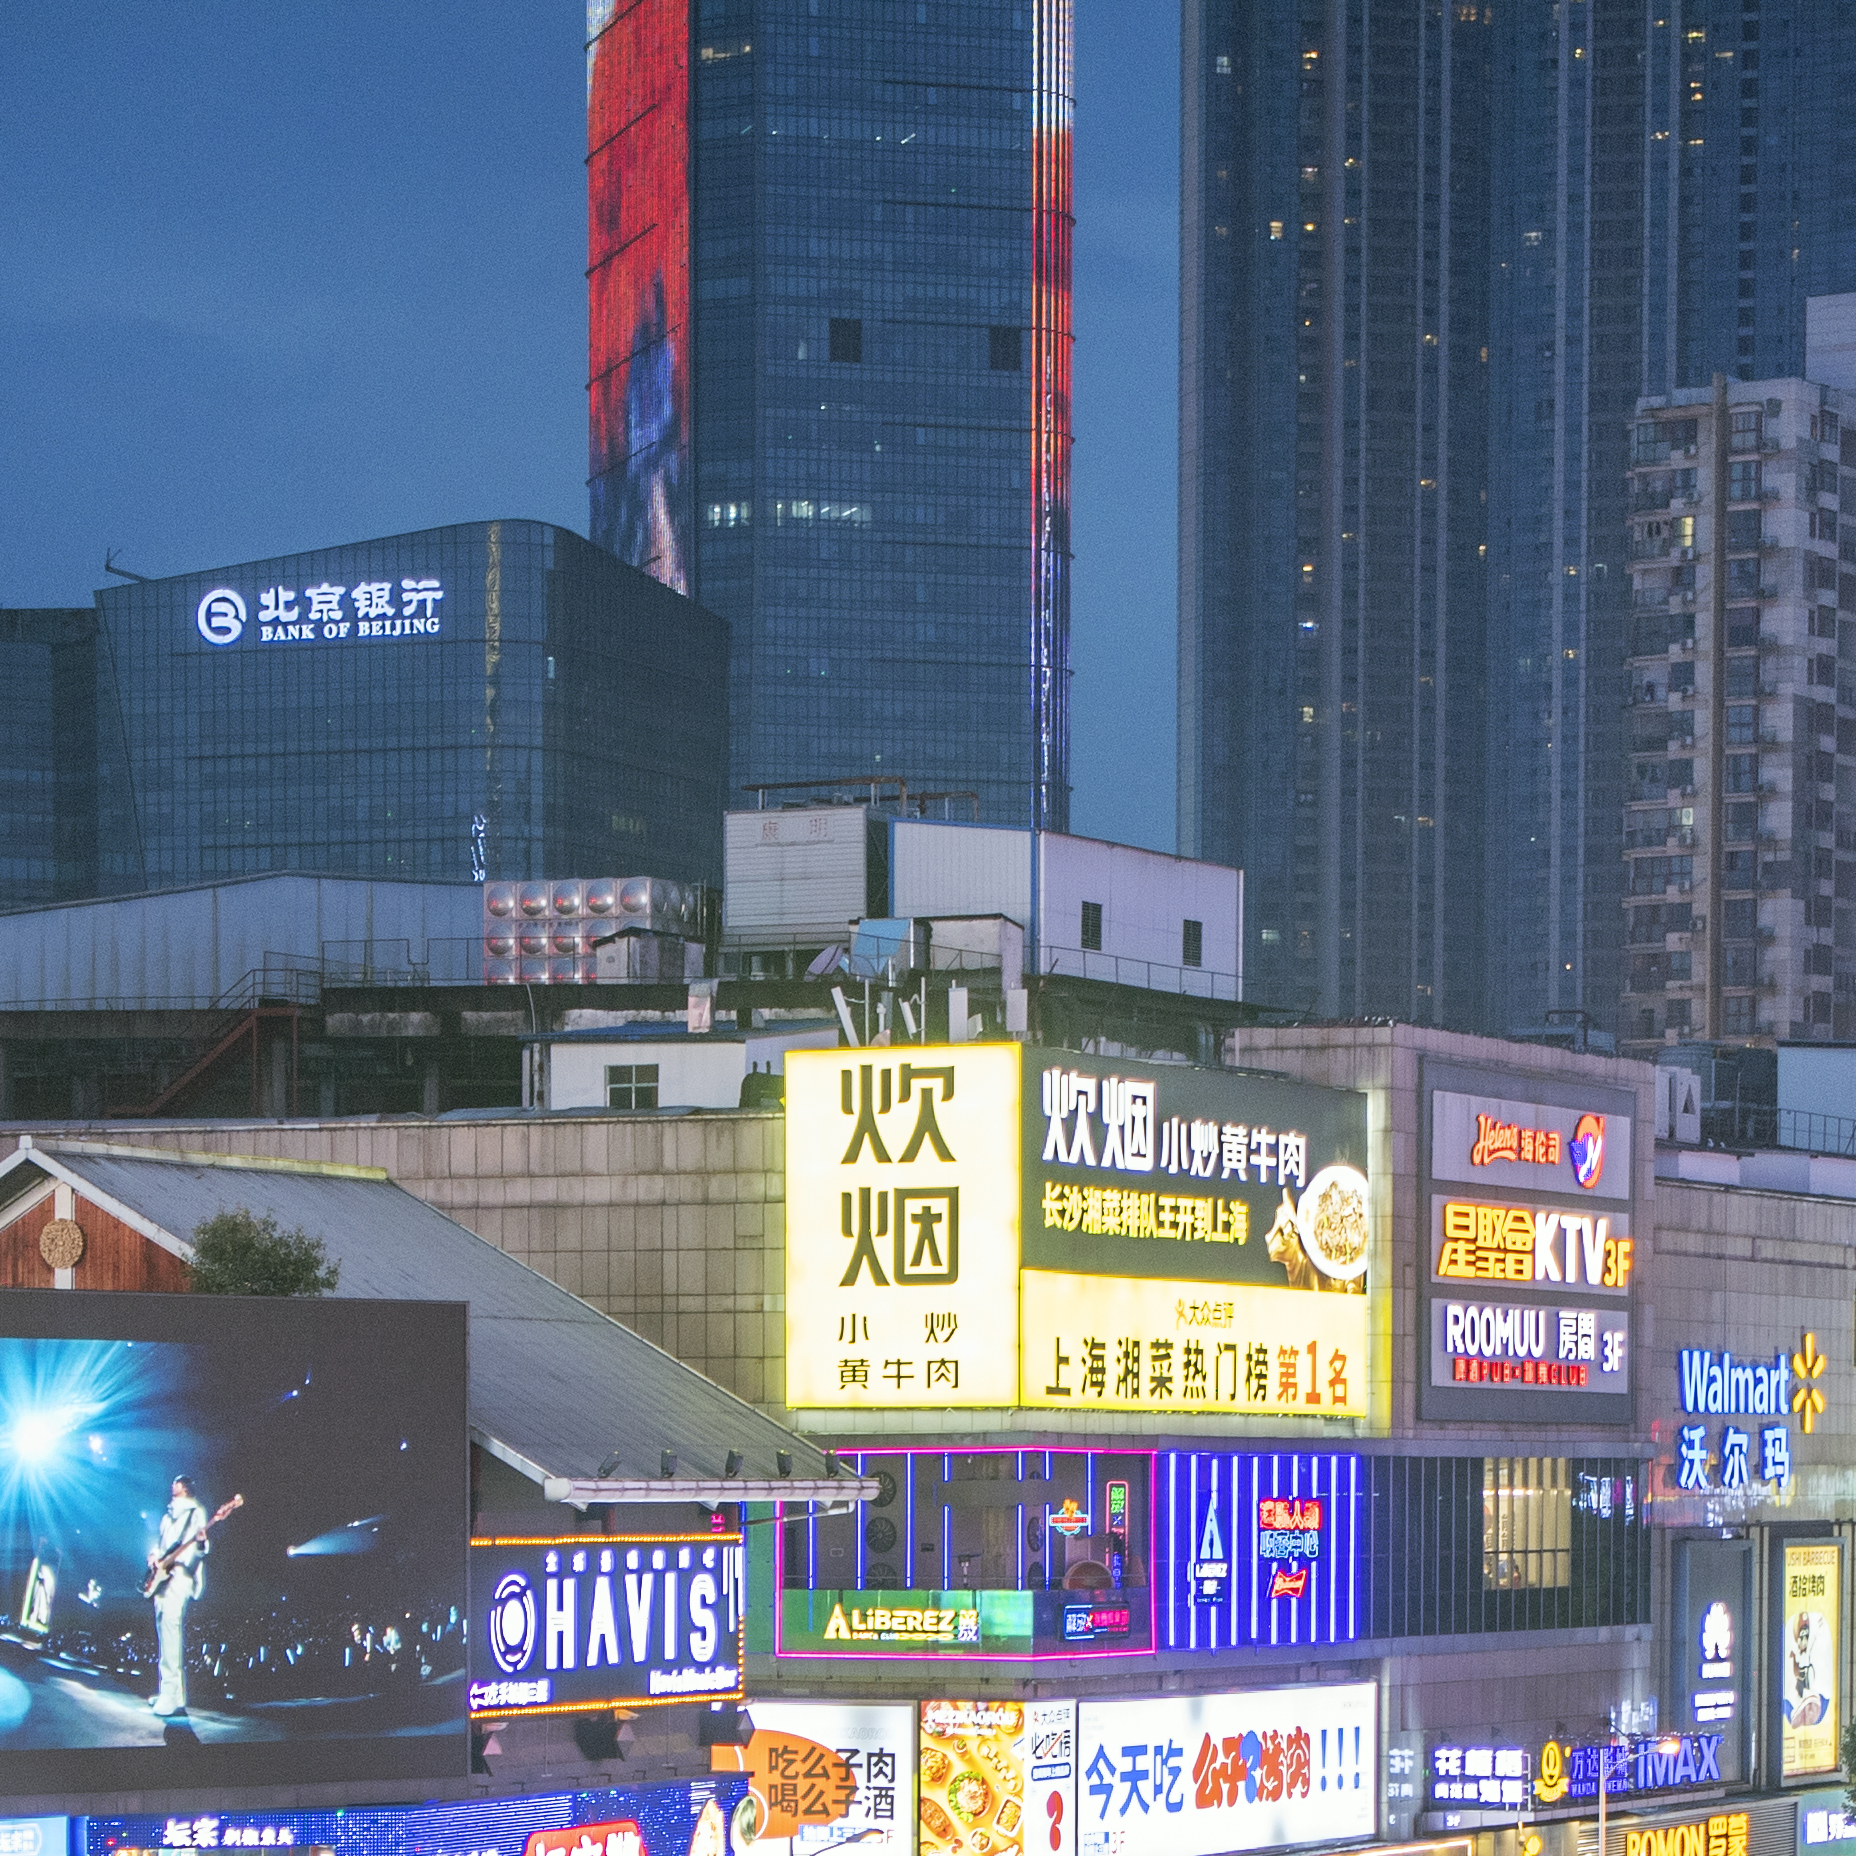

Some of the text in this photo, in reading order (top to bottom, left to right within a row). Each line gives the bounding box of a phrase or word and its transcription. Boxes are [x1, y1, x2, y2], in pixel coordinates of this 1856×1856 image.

[258, 579, 443, 622] 北京银行
[261, 617, 440, 641] BANK OF BEIJING
[1042, 1069, 1306, 1188] 炊烟 小炒黄牛肉
[1520, 1129, 1560, 1164] 海伦司
[839, 1064, 959, 1287] 炊烟
[1042, 1182, 1249, 1244] 长沙湘菜排队王开到上海
[1535, 1212, 1632, 1287] KTV 3F
[839, 1313, 958, 1344] 小炒
[1189, 1299, 1234, 1328] 大众点评
[1447, 1304, 1544, 1357] ROOMUU
[1602, 1331, 1625, 1373] 3F
[838, 1358, 958, 1390] 黄牛肉
[1045, 1337, 1348, 1407] 上海湘菜热门榜第1名
[1681, 1350, 1790, 1415] Walmart
[1678, 1426, 1790, 1489] 沃尔玛
[546, 1571, 717, 1670] HAVIS
[768, 1746, 896, 1783] 吃么子肉
[1085, 1738, 1184, 1820] 今天吃
[1637, 1735, 1722, 1790] IMAX
[768, 1784, 896, 1819] 喝么子酒
